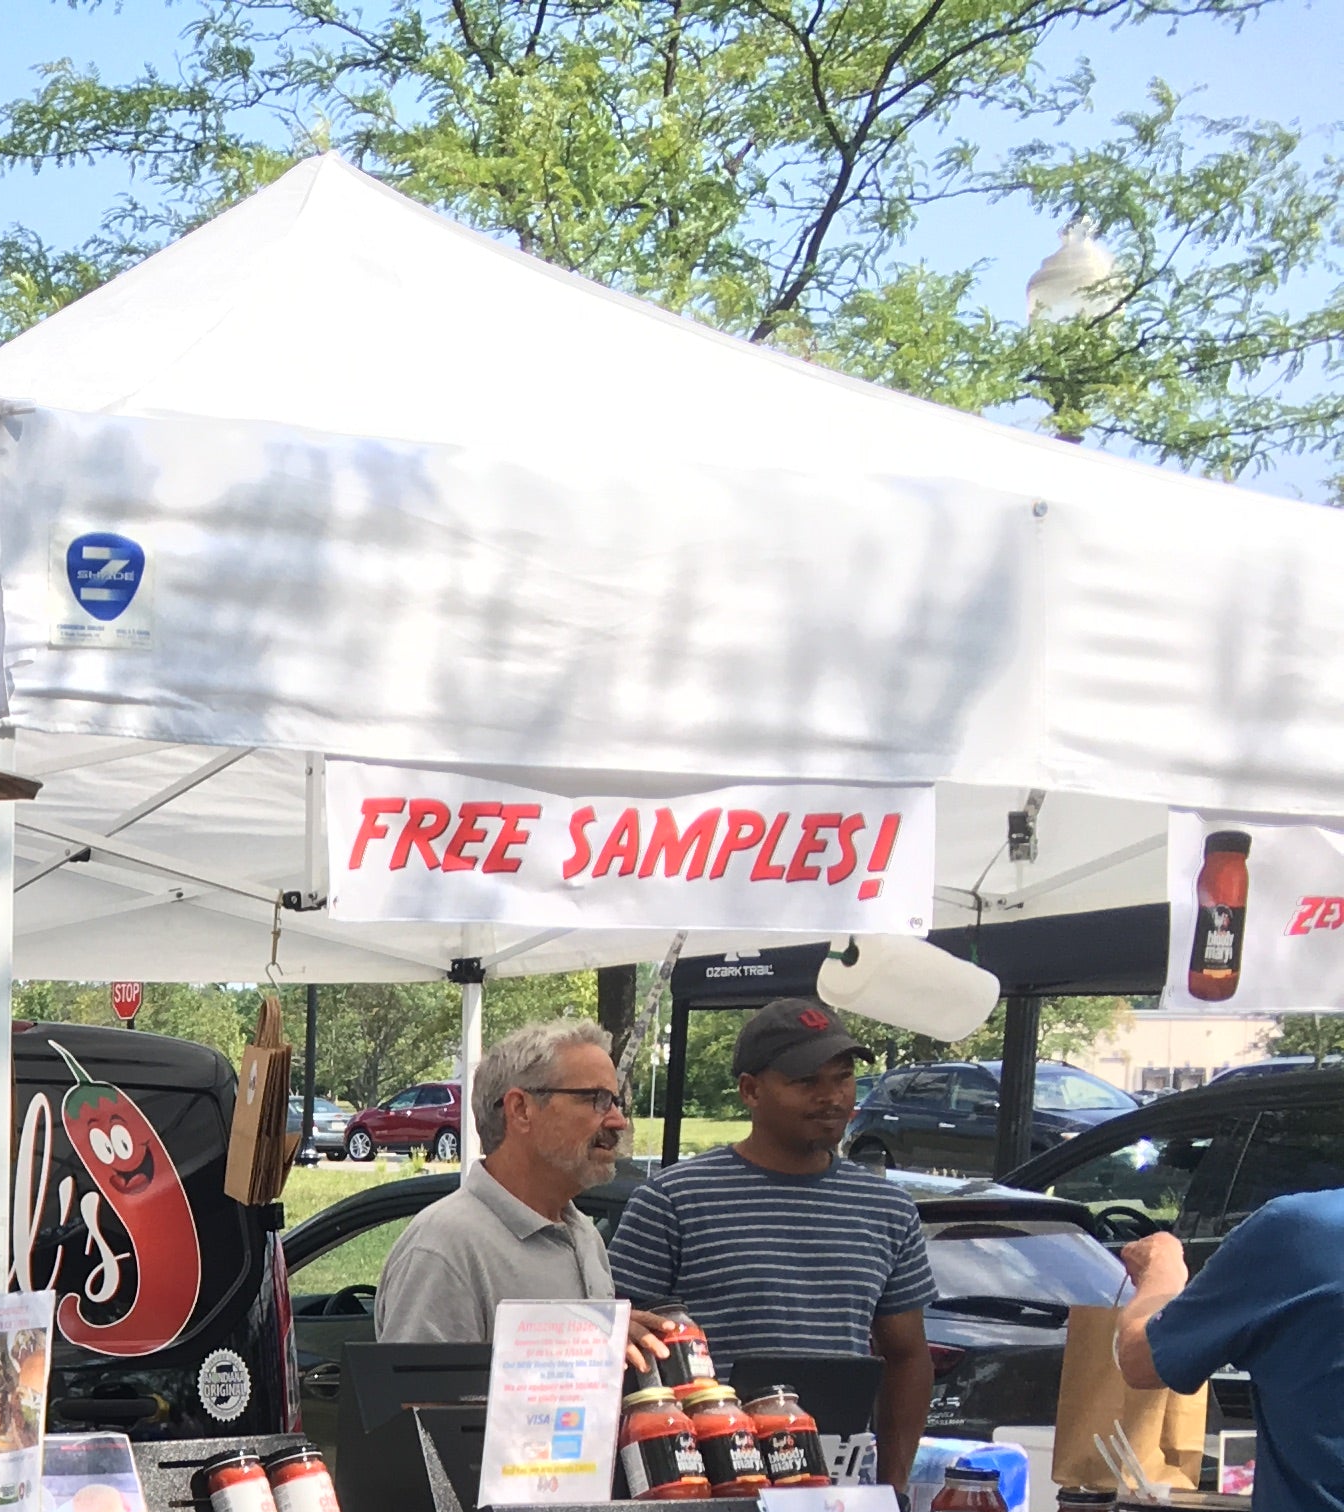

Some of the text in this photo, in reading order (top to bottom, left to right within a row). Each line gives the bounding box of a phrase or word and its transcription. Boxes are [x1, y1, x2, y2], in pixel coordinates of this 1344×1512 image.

[348, 795, 903, 901] FREE SAMPLES!
[114, 982, 140, 1004] STOP
[517, 1319, 563, 1334] Amazing
[203, 1383, 247, 1398] ORIGINAL
[526, 1414, 552, 1426] VISA
[768, 1446, 805, 1464] bloody
